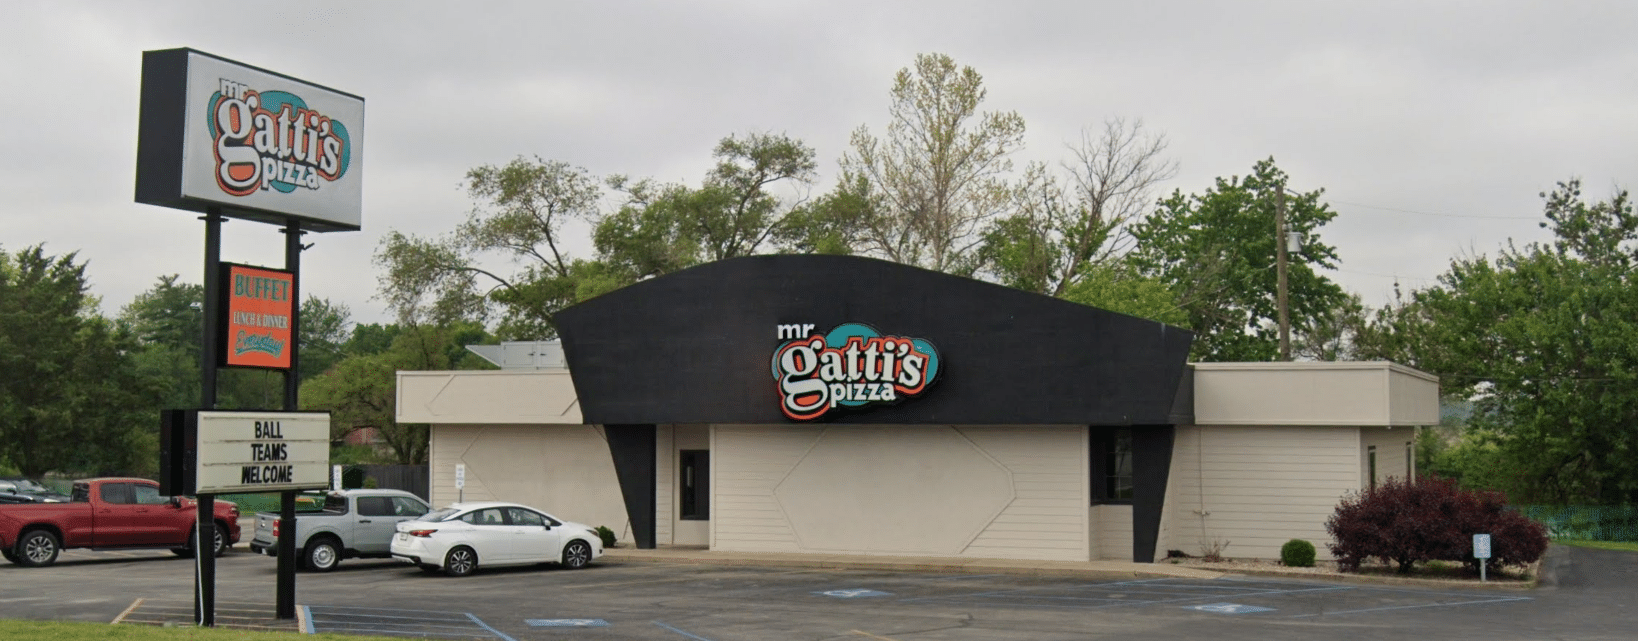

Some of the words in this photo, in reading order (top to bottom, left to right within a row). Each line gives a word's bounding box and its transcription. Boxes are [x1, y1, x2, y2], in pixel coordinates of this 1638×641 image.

[219, 78, 248, 101] mr
[218, 95, 340, 187] gatti's
[260, 151, 320, 191] pizza
[235, 274, 291, 302] BUFFET
[233, 311, 255, 325] LUNCH
[263, 314, 288, 329] DINNER
[777, 323, 816, 339] mr
[781, 340, 923, 411] gatti's
[829, 376, 896, 408] pizza
[255, 421, 283, 439] BALL
[251, 443, 288, 461] TEAMS
[241, 465, 293, 484] WELCOME
